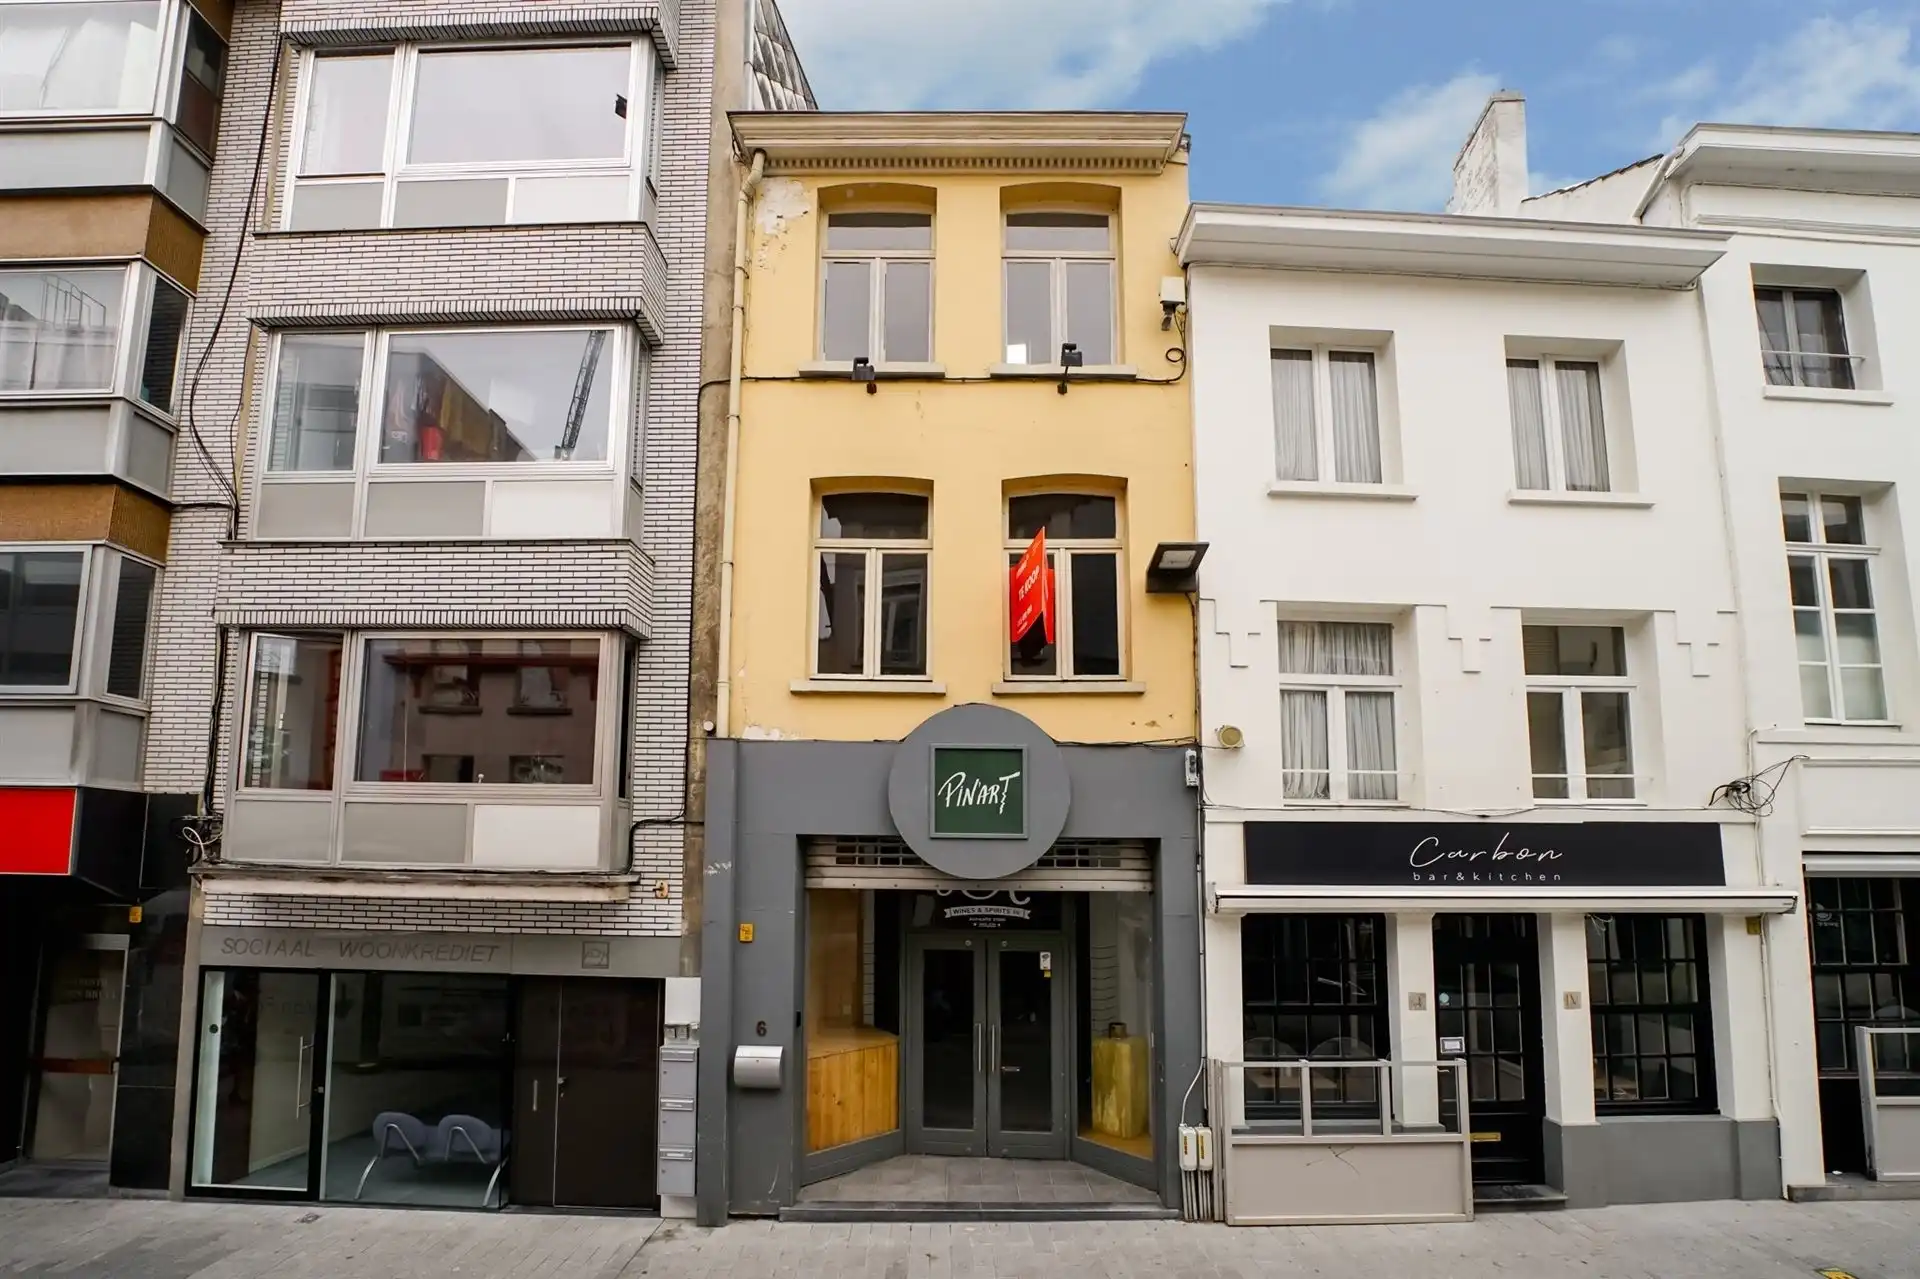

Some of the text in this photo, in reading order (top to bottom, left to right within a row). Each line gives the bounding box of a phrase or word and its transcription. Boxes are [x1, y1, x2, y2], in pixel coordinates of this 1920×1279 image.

[1024, 565, 1040, 595] KOOP
[1410, 832, 1563, 868] Carbon
[952, 907, 976, 915] WINES
[985, 907, 1010, 915] SPIRITS
[221, 938, 499, 963] SOCIAAL WOONKREDIET
[756, 1020, 767, 1037] 6
